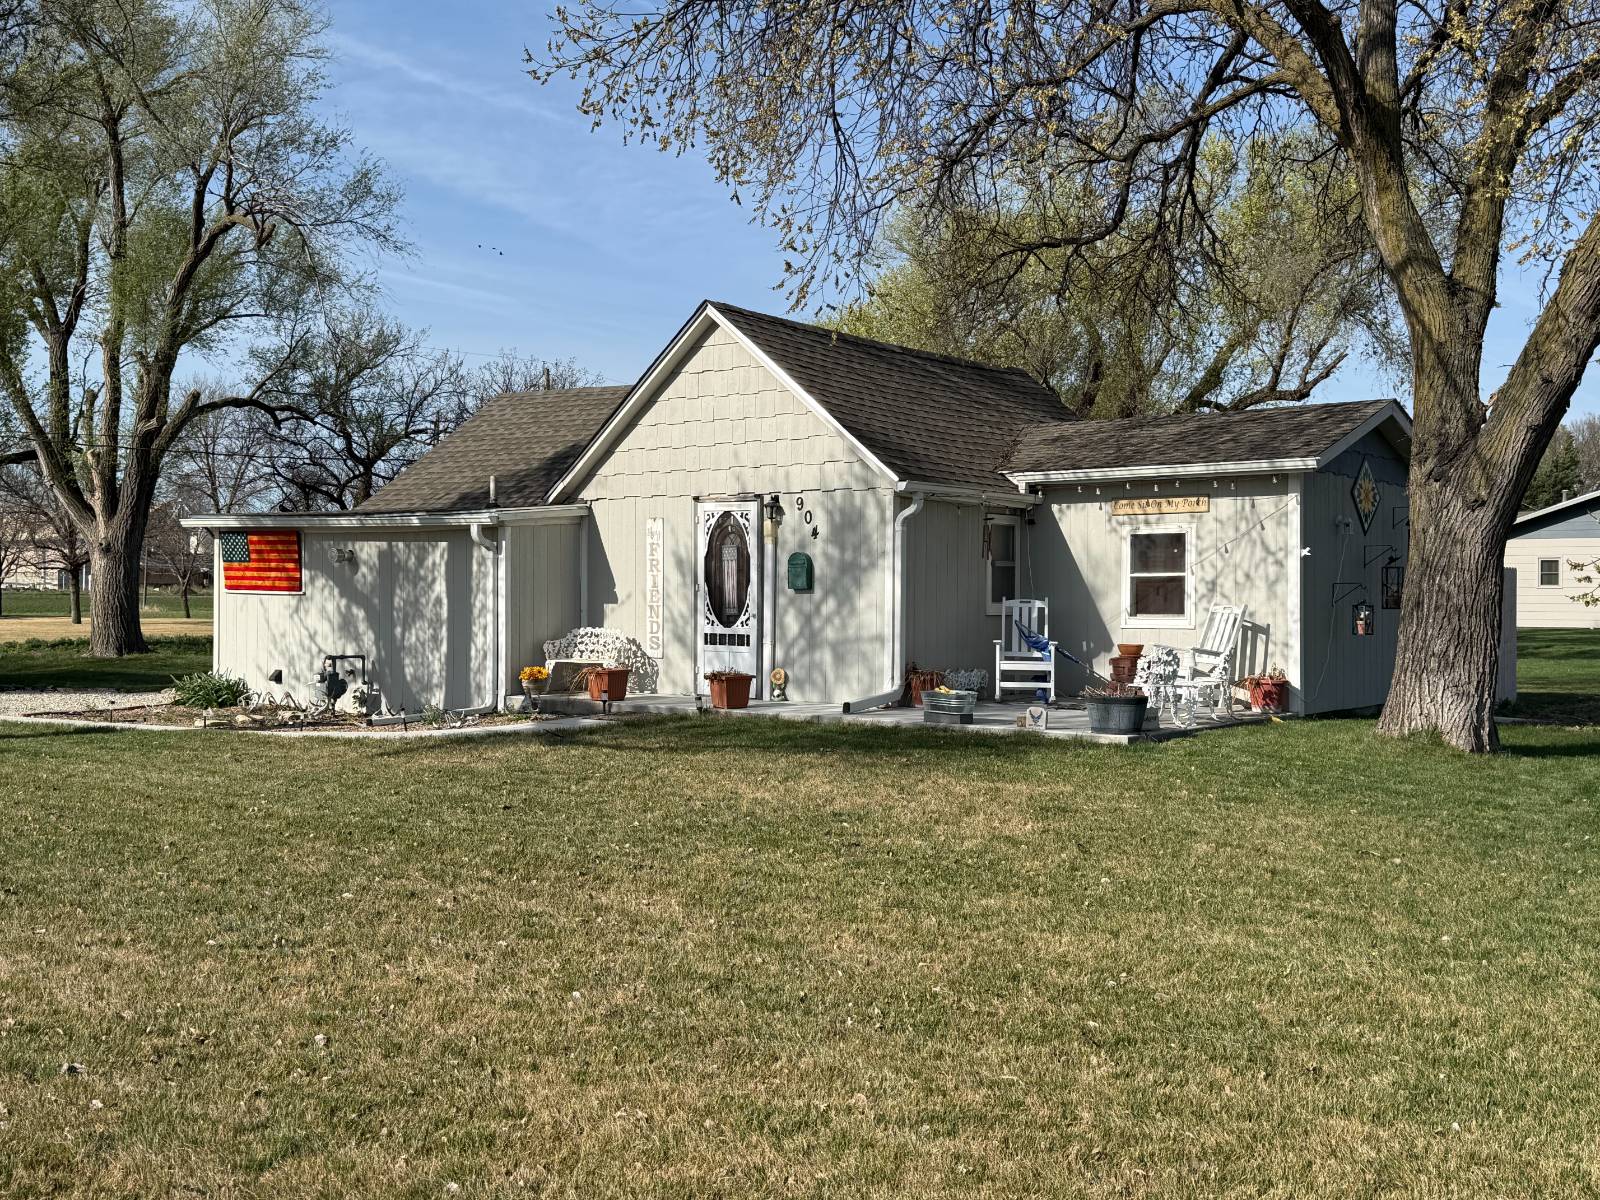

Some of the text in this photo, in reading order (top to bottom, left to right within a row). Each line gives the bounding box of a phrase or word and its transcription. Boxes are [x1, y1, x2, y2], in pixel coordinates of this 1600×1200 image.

[795, 496, 820, 541] 904
[1113, 500, 1135, 510] Come
[1165, 498, 1180, 509] My
[648, 542, 661, 651] FRIENDS
